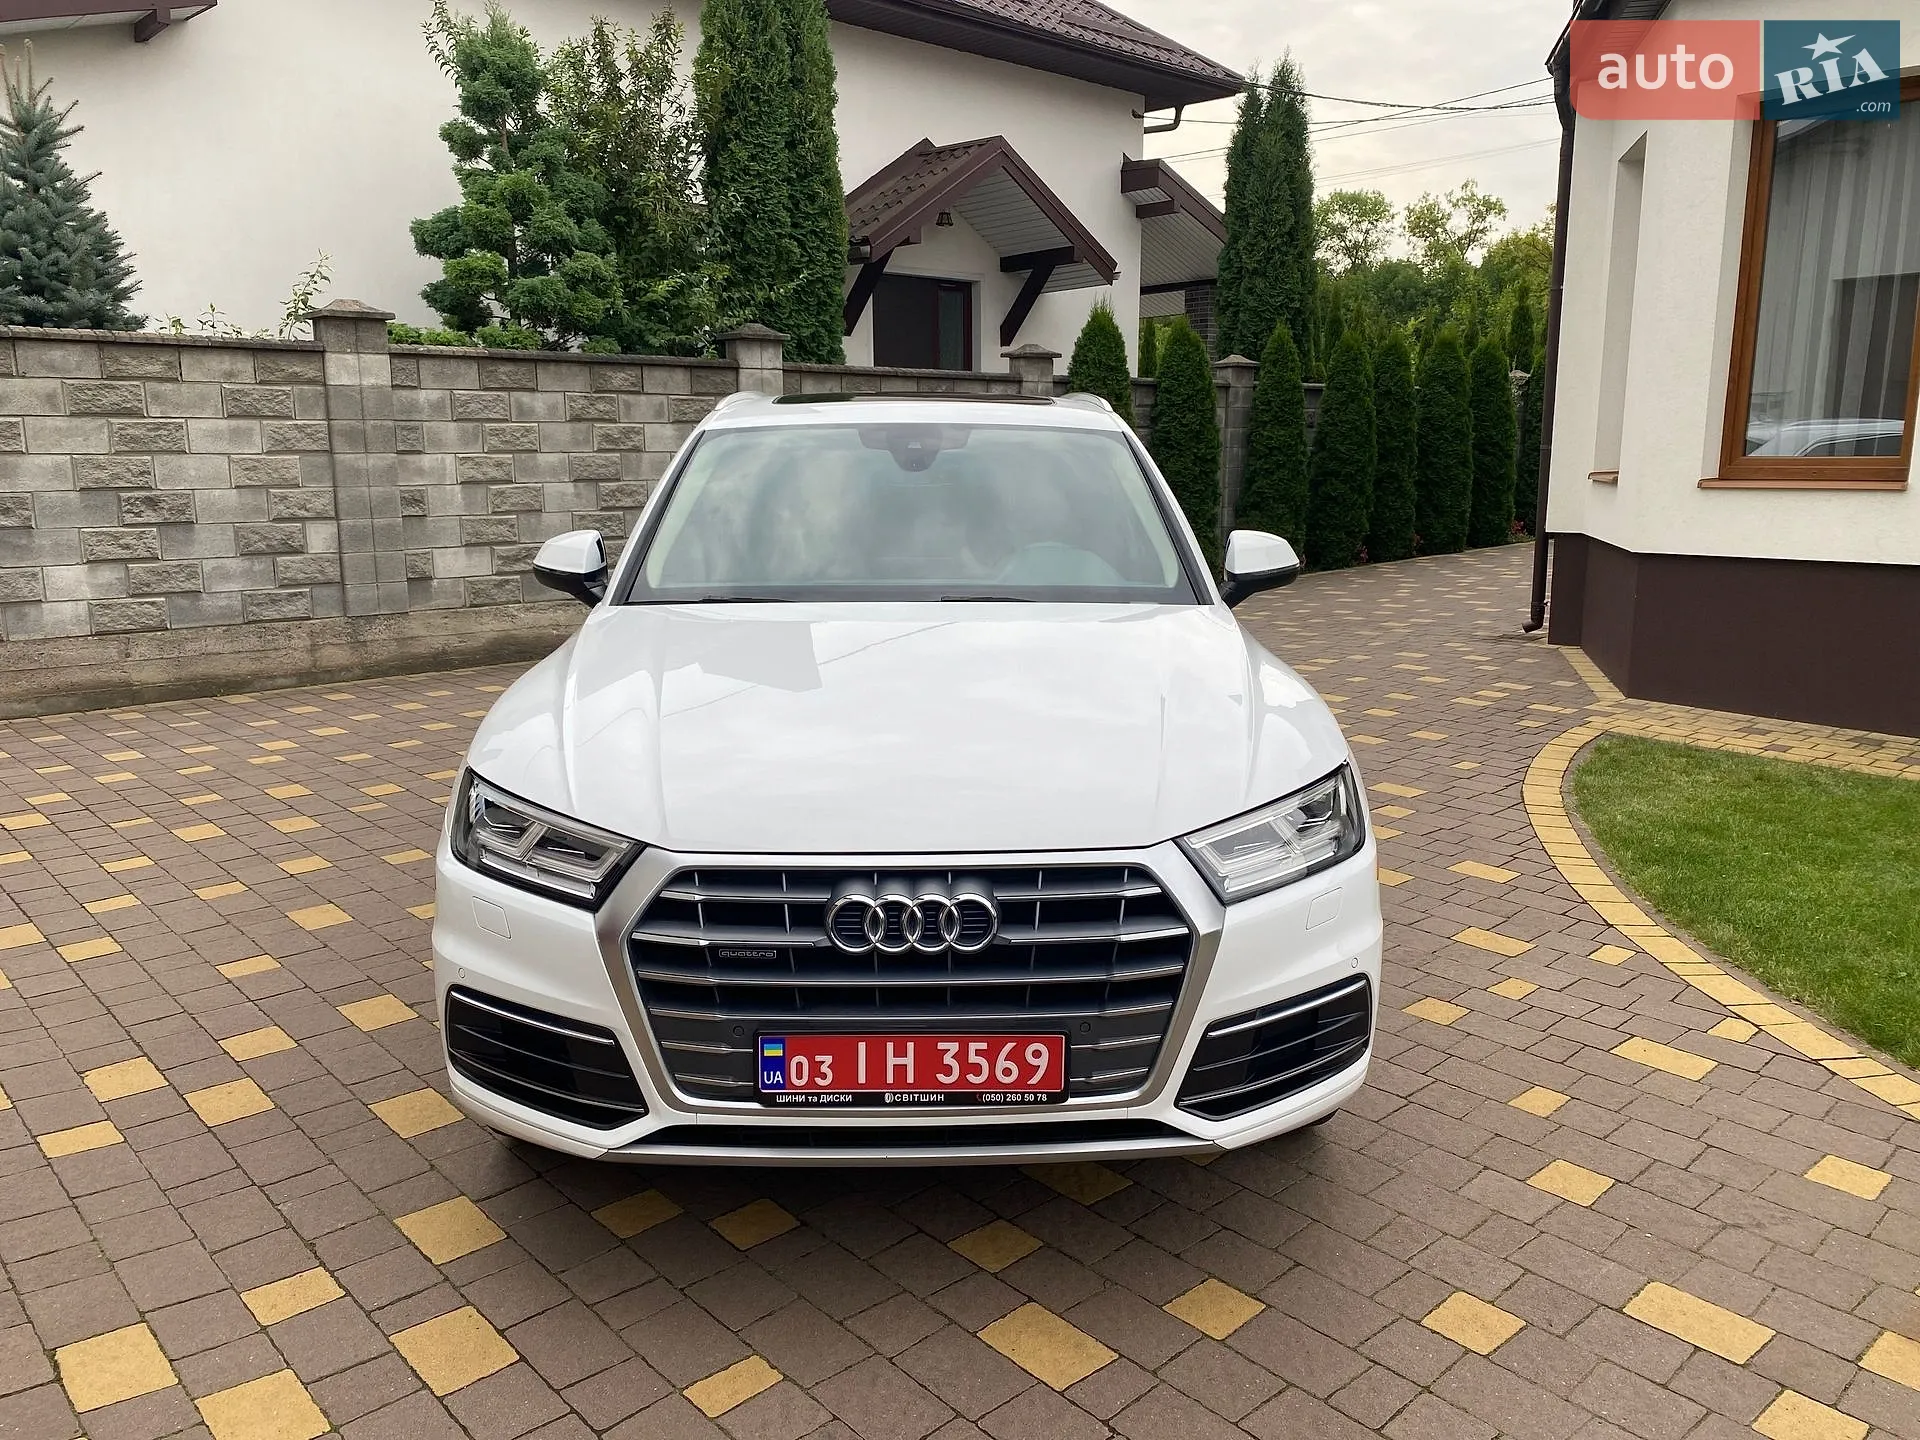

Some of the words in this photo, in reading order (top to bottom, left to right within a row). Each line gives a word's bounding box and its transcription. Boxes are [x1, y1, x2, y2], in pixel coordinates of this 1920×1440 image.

[721, 950, 774, 958] quattro
[789, 1055, 834, 1087] 03
[935, 1042, 1049, 1085] 3569
[763, 1071, 783, 1084] UA
[776, 1094, 806, 1103] ШИНИ
[819, 1094, 853, 1104] ДИСКИ
[982, 1093, 1004, 1103] (050)
[1006, 1093, 1022, 1102] 260
[1024, 1093, 1035, 1102] 50
[1036, 1093, 1048, 1102] 78
